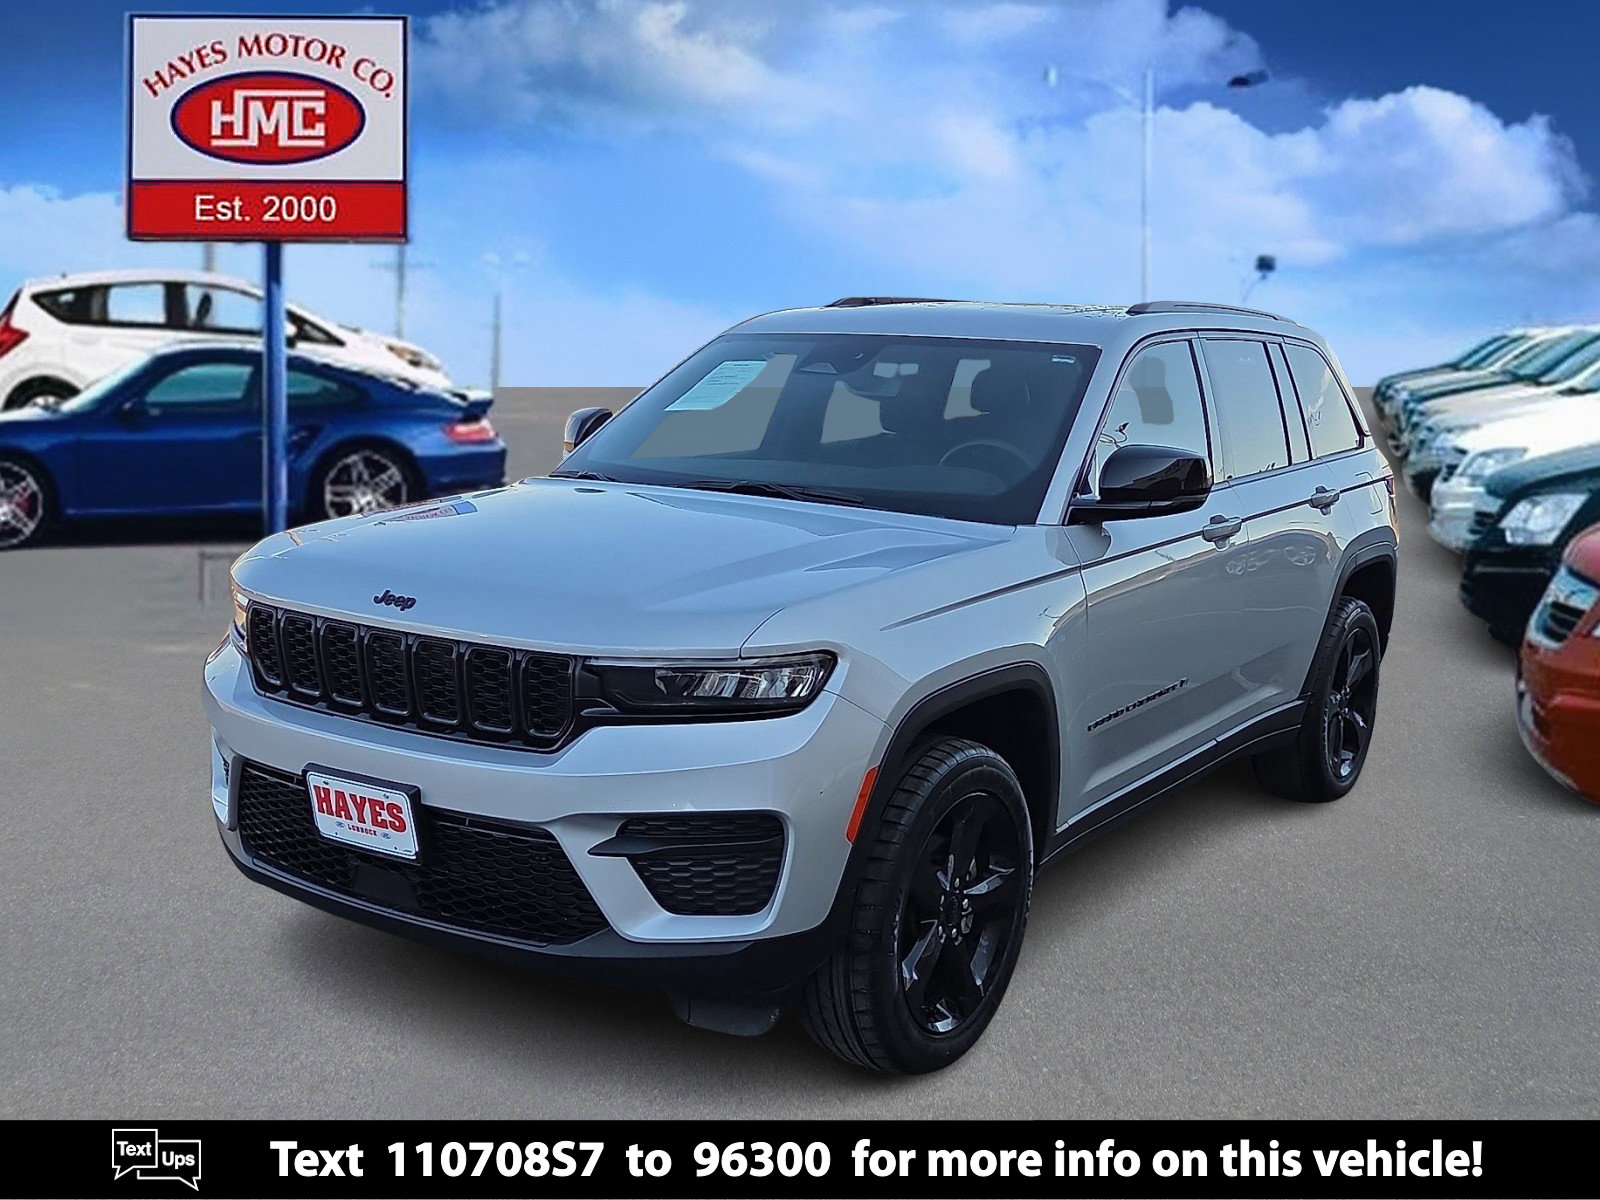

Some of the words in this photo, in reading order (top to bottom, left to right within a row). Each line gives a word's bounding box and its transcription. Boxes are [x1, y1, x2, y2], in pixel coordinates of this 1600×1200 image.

[143, 41, 227, 97] HAYES
[238, 33, 346, 69] MOTOR
[353, 57, 394, 98] CO.
[210, 89, 326, 147] HMC
[195, 195, 250, 221] Est.
[262, 196, 337, 222] 2000
[373, 589, 417, 611] Jeep
[313, 785, 407, 833] HAYES
